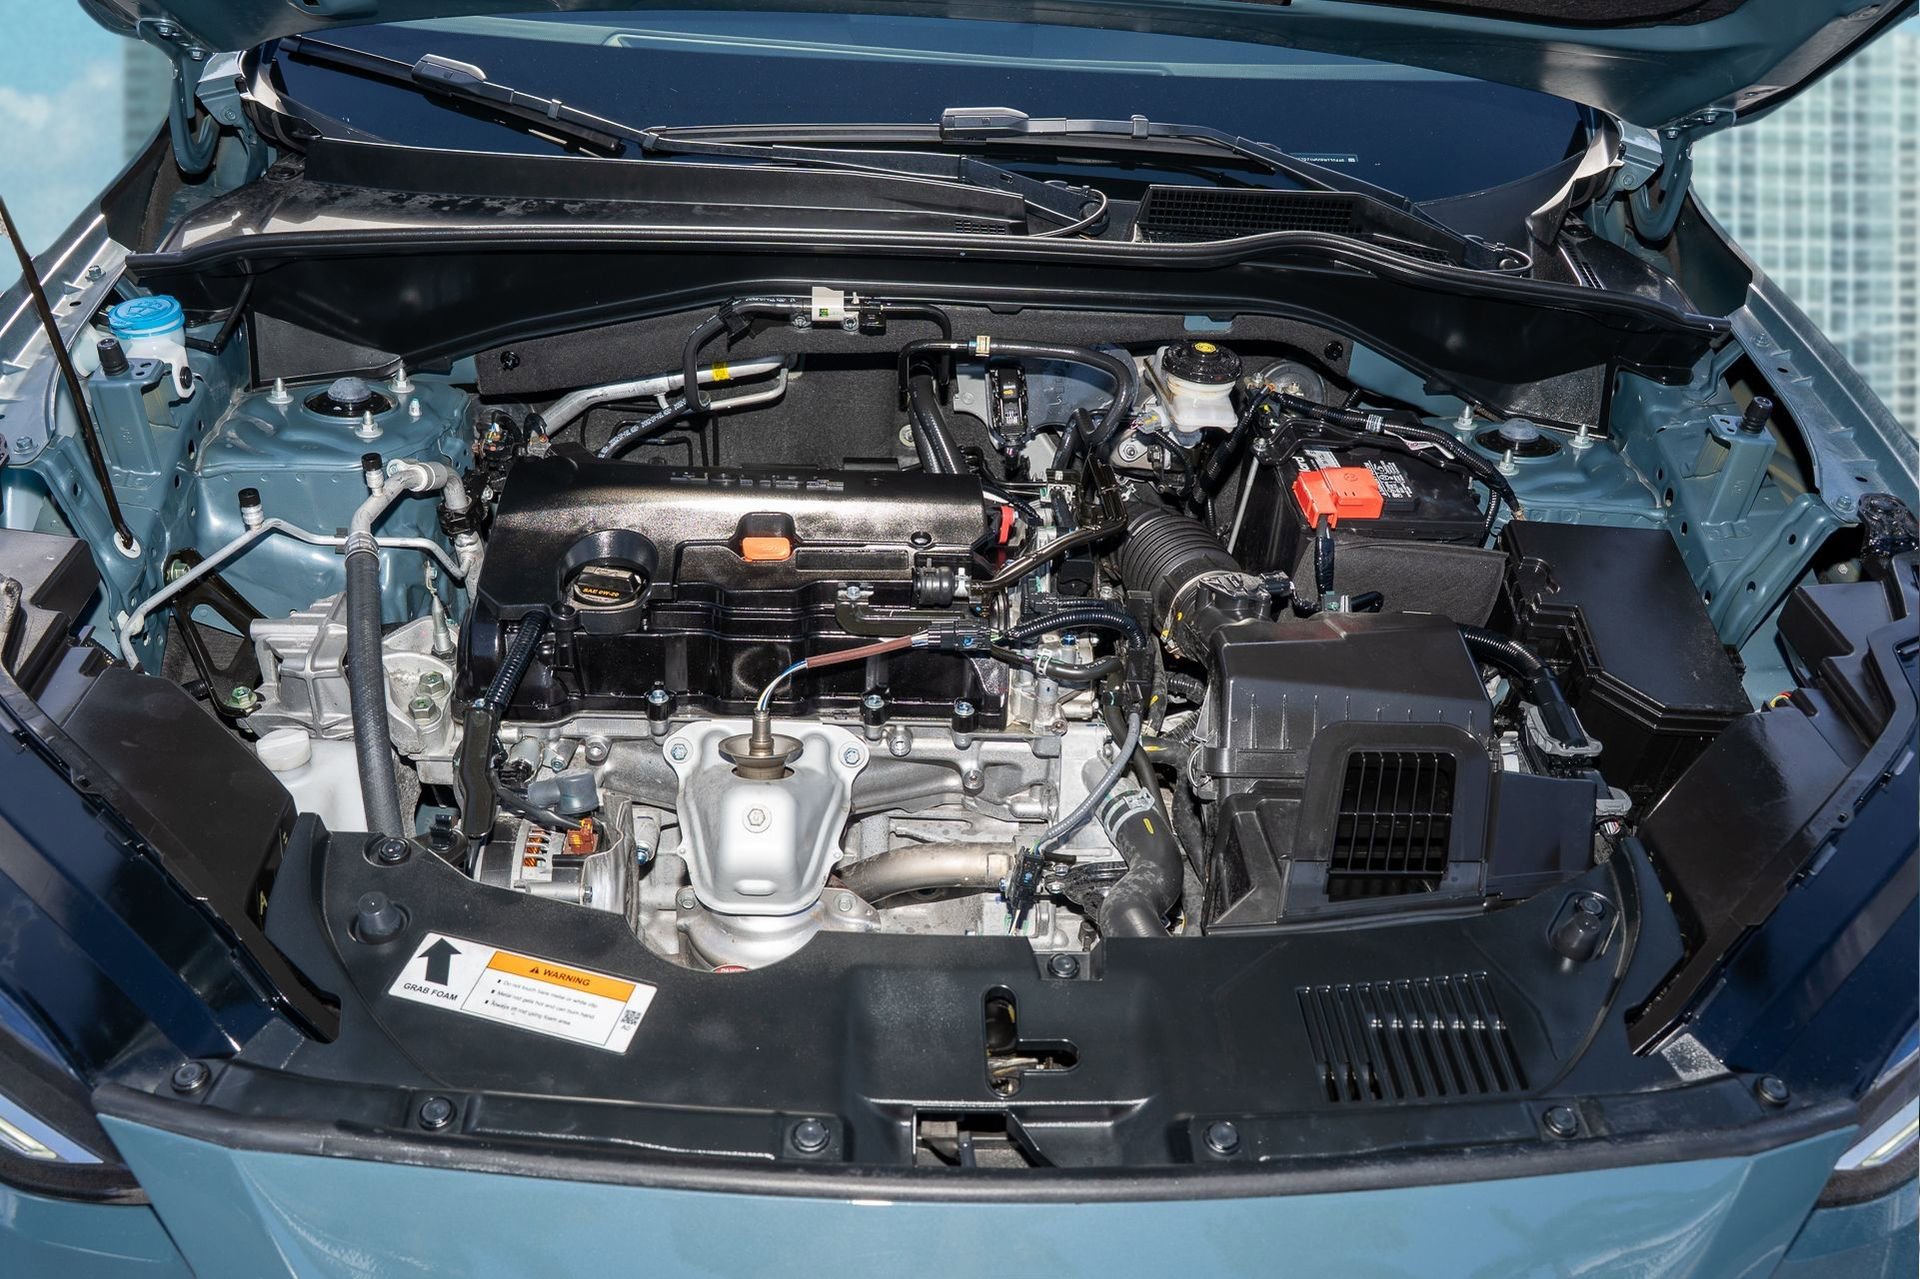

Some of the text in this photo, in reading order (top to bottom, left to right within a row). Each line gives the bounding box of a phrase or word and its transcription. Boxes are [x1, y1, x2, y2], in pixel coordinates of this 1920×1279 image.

[583, 587, 598, 595] SAE
[543, 968, 591, 987] WARNING
[403, 982, 458, 1001] GRAB FOAM
